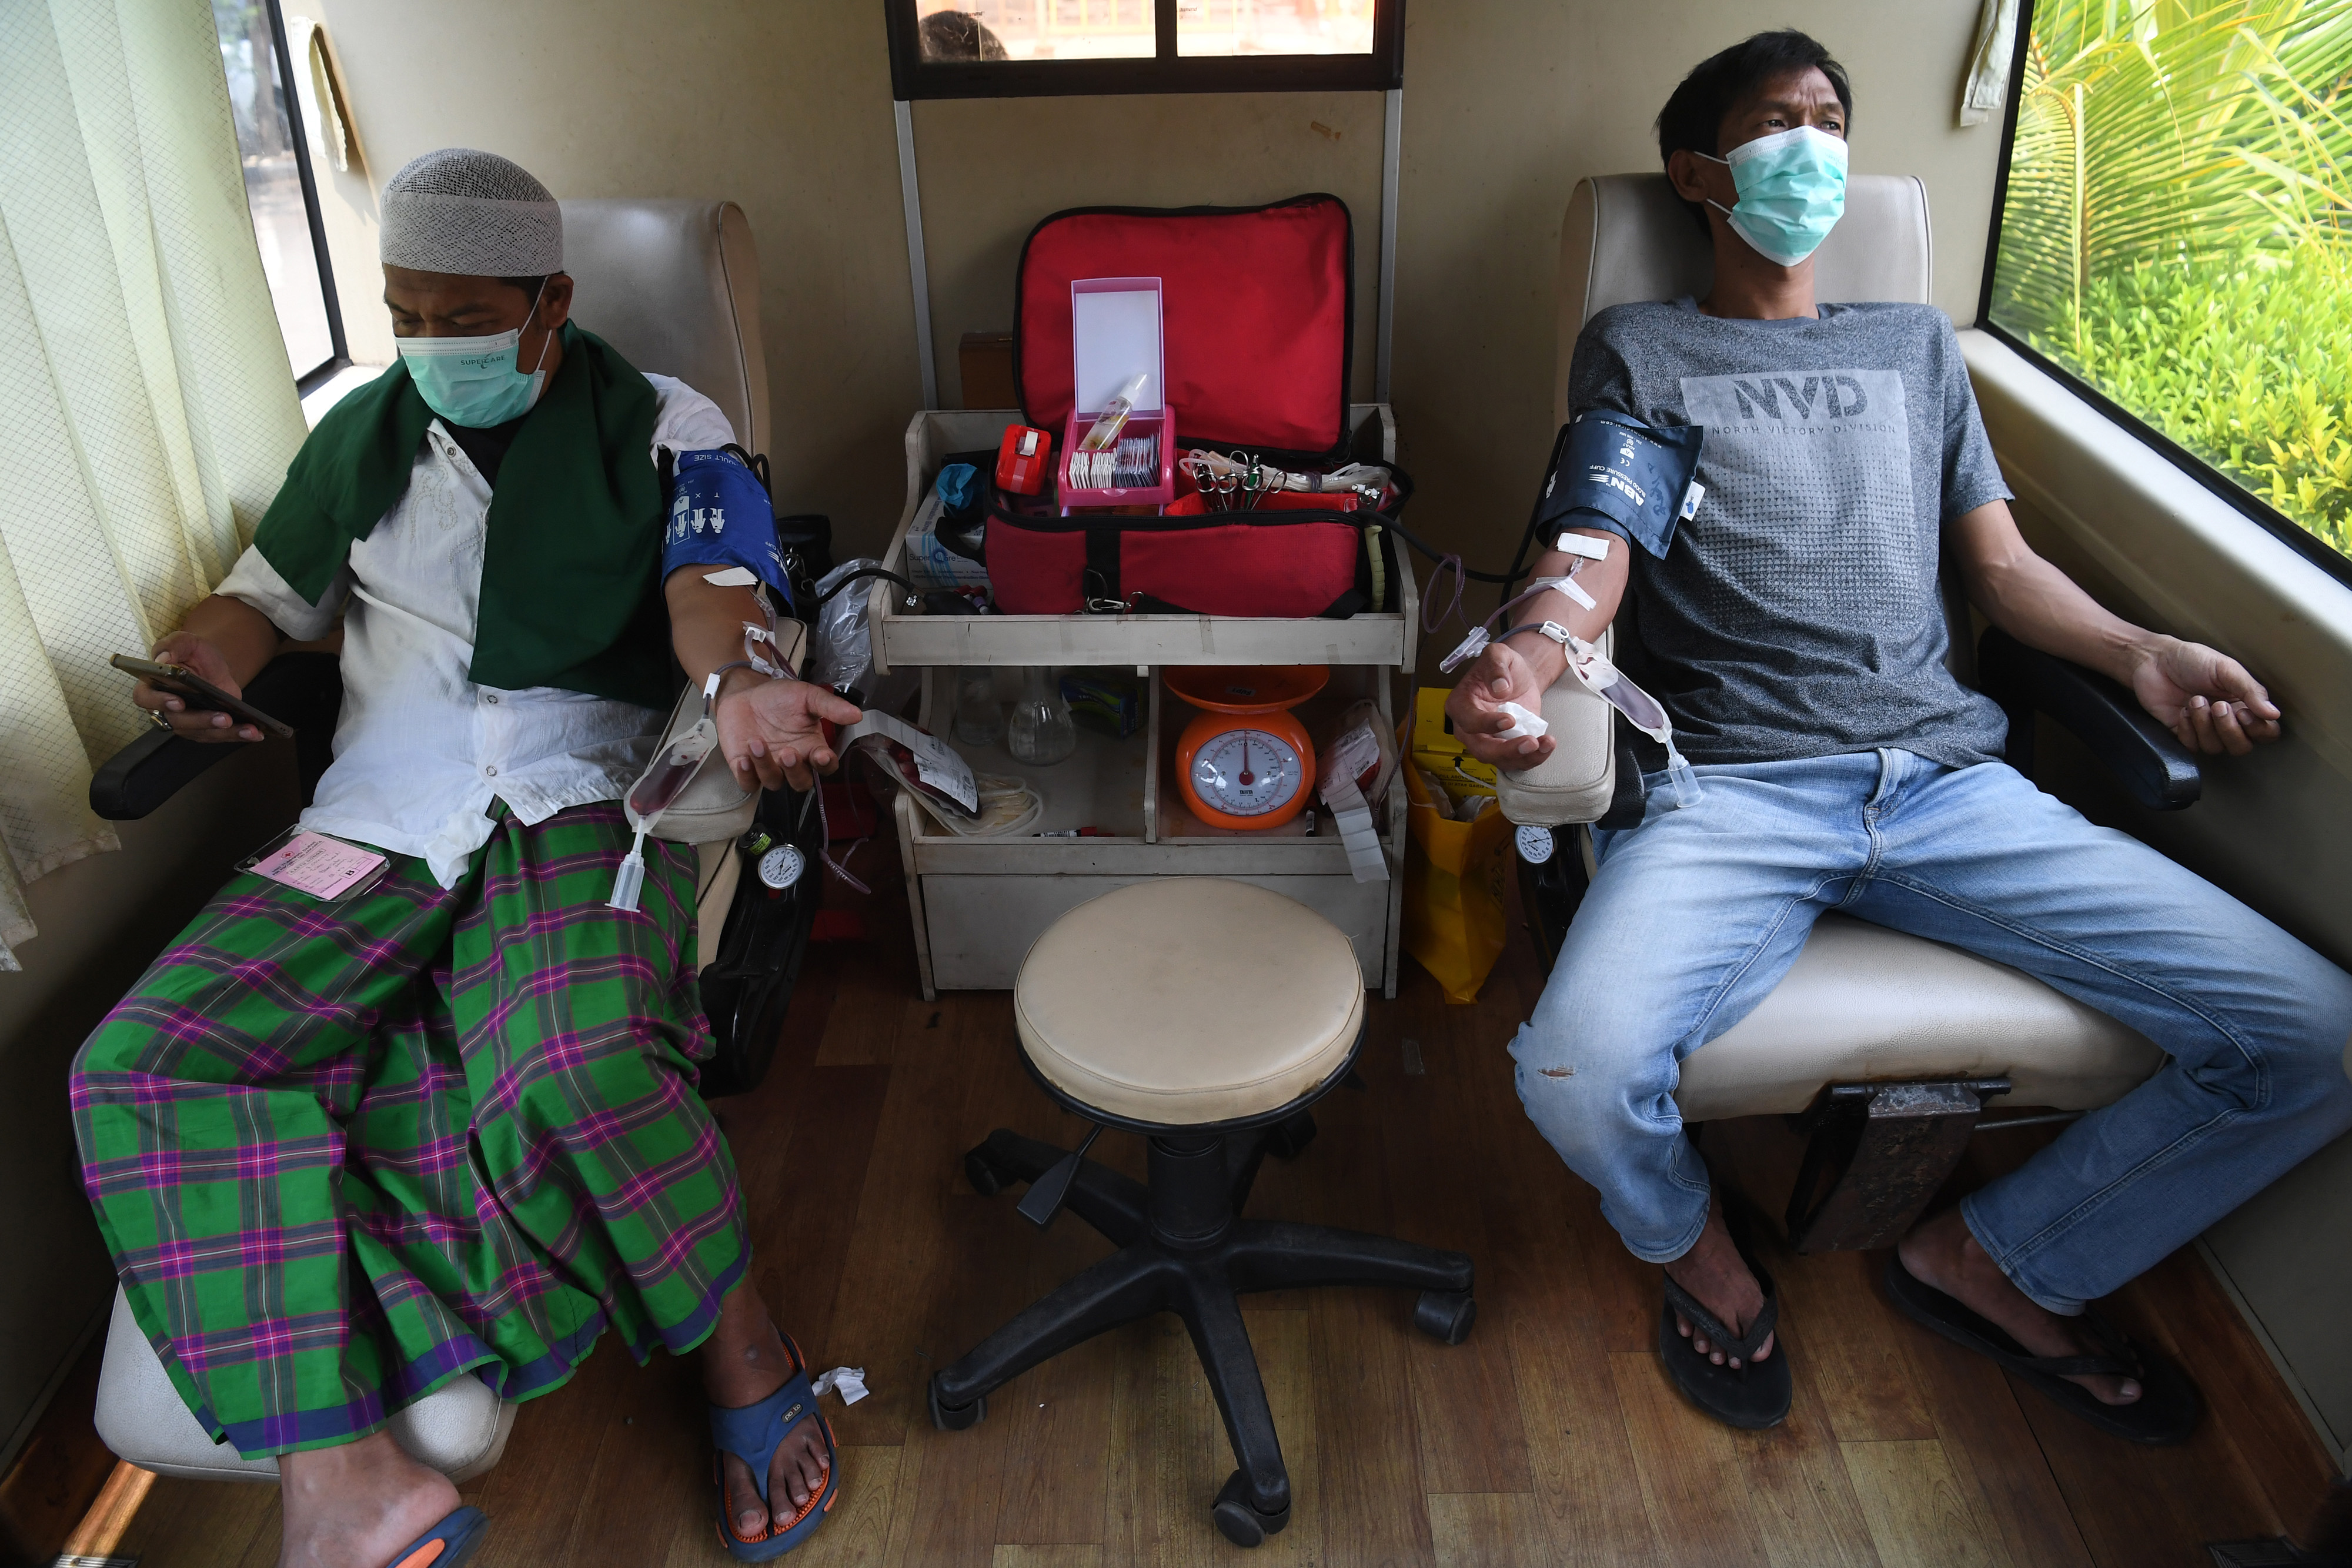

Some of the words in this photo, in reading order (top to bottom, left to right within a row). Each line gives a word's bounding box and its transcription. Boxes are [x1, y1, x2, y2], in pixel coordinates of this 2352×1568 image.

[1735, 375, 1868, 419] NVD
[1601, 420, 1662, 449] www.abnmedical.com
[1712, 426, 1759, 434] NORTH
[1768, 426, 1824, 434] VICTORY
[1834, 423, 1896, 434] DIVISION
[1606, 467, 1633, 485] PRESSURE
[1611, 477, 1644, 506] ABN
[1633, 483, 1646, 498] BLOOD
[765, 541, 776, 551] CUFF
[909, 554, 930, 563] Super
